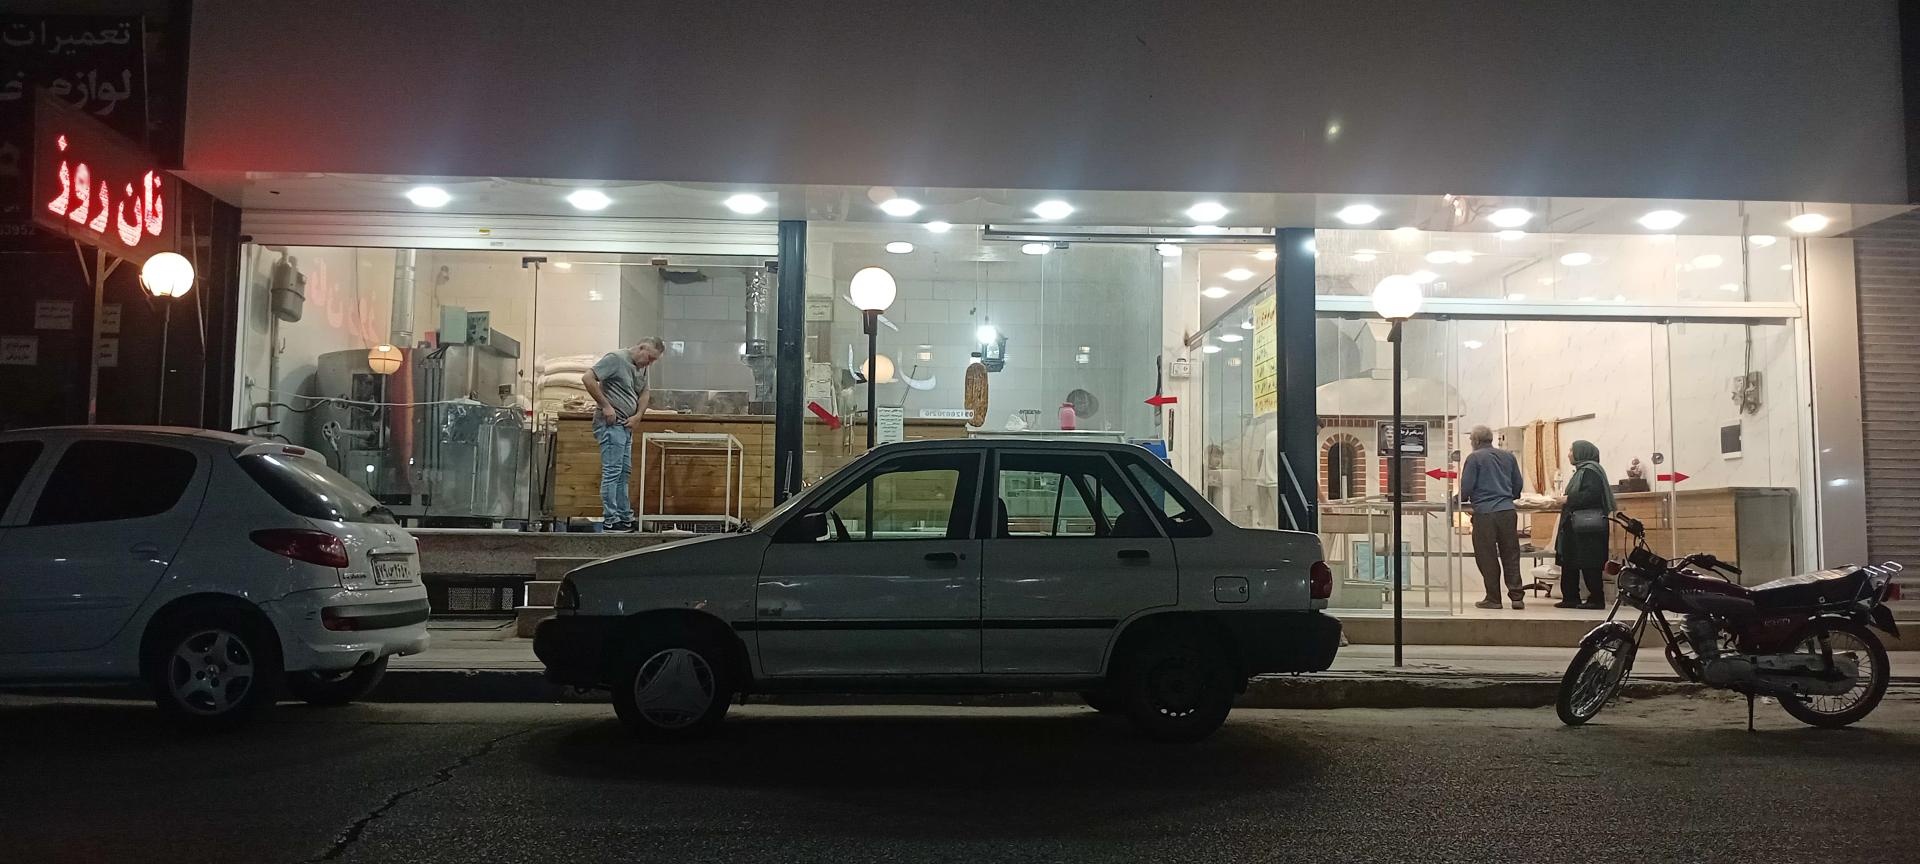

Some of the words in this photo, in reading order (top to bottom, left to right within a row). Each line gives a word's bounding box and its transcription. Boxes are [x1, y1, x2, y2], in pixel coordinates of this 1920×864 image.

[3, 20, 131, 54] تعمیرات
[47, 134, 110, 234] روز
[117, 170, 164, 247] نان
